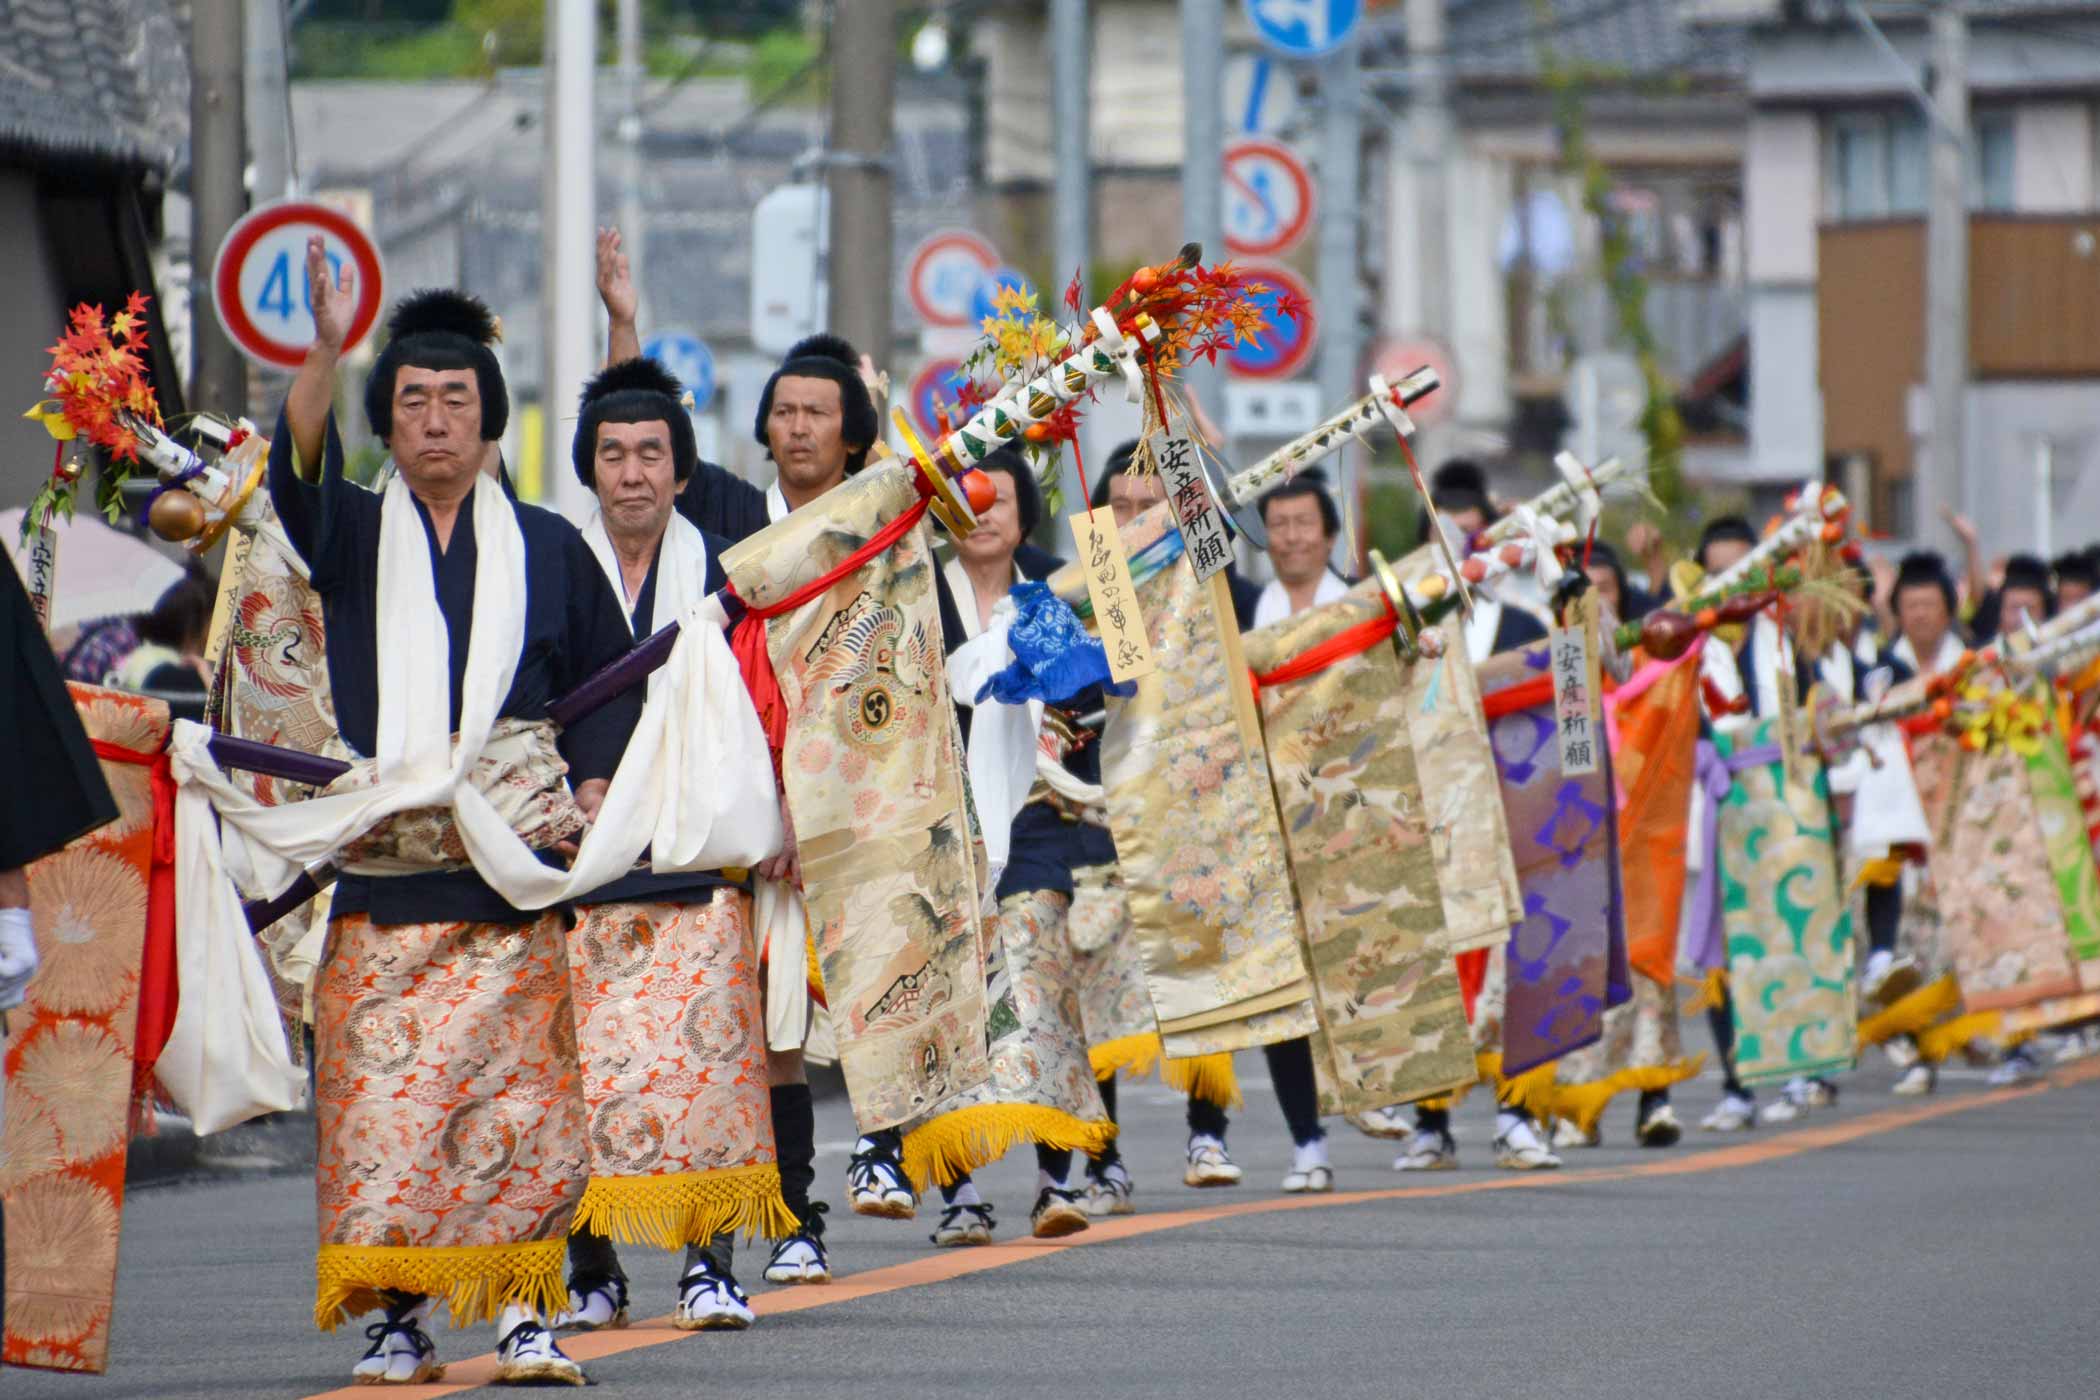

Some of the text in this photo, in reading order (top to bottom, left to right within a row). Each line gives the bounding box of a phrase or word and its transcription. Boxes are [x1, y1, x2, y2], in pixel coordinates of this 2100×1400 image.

[1160, 438, 1226, 573] 安産祈願
[1556, 642, 1592, 767] 安産祈願
